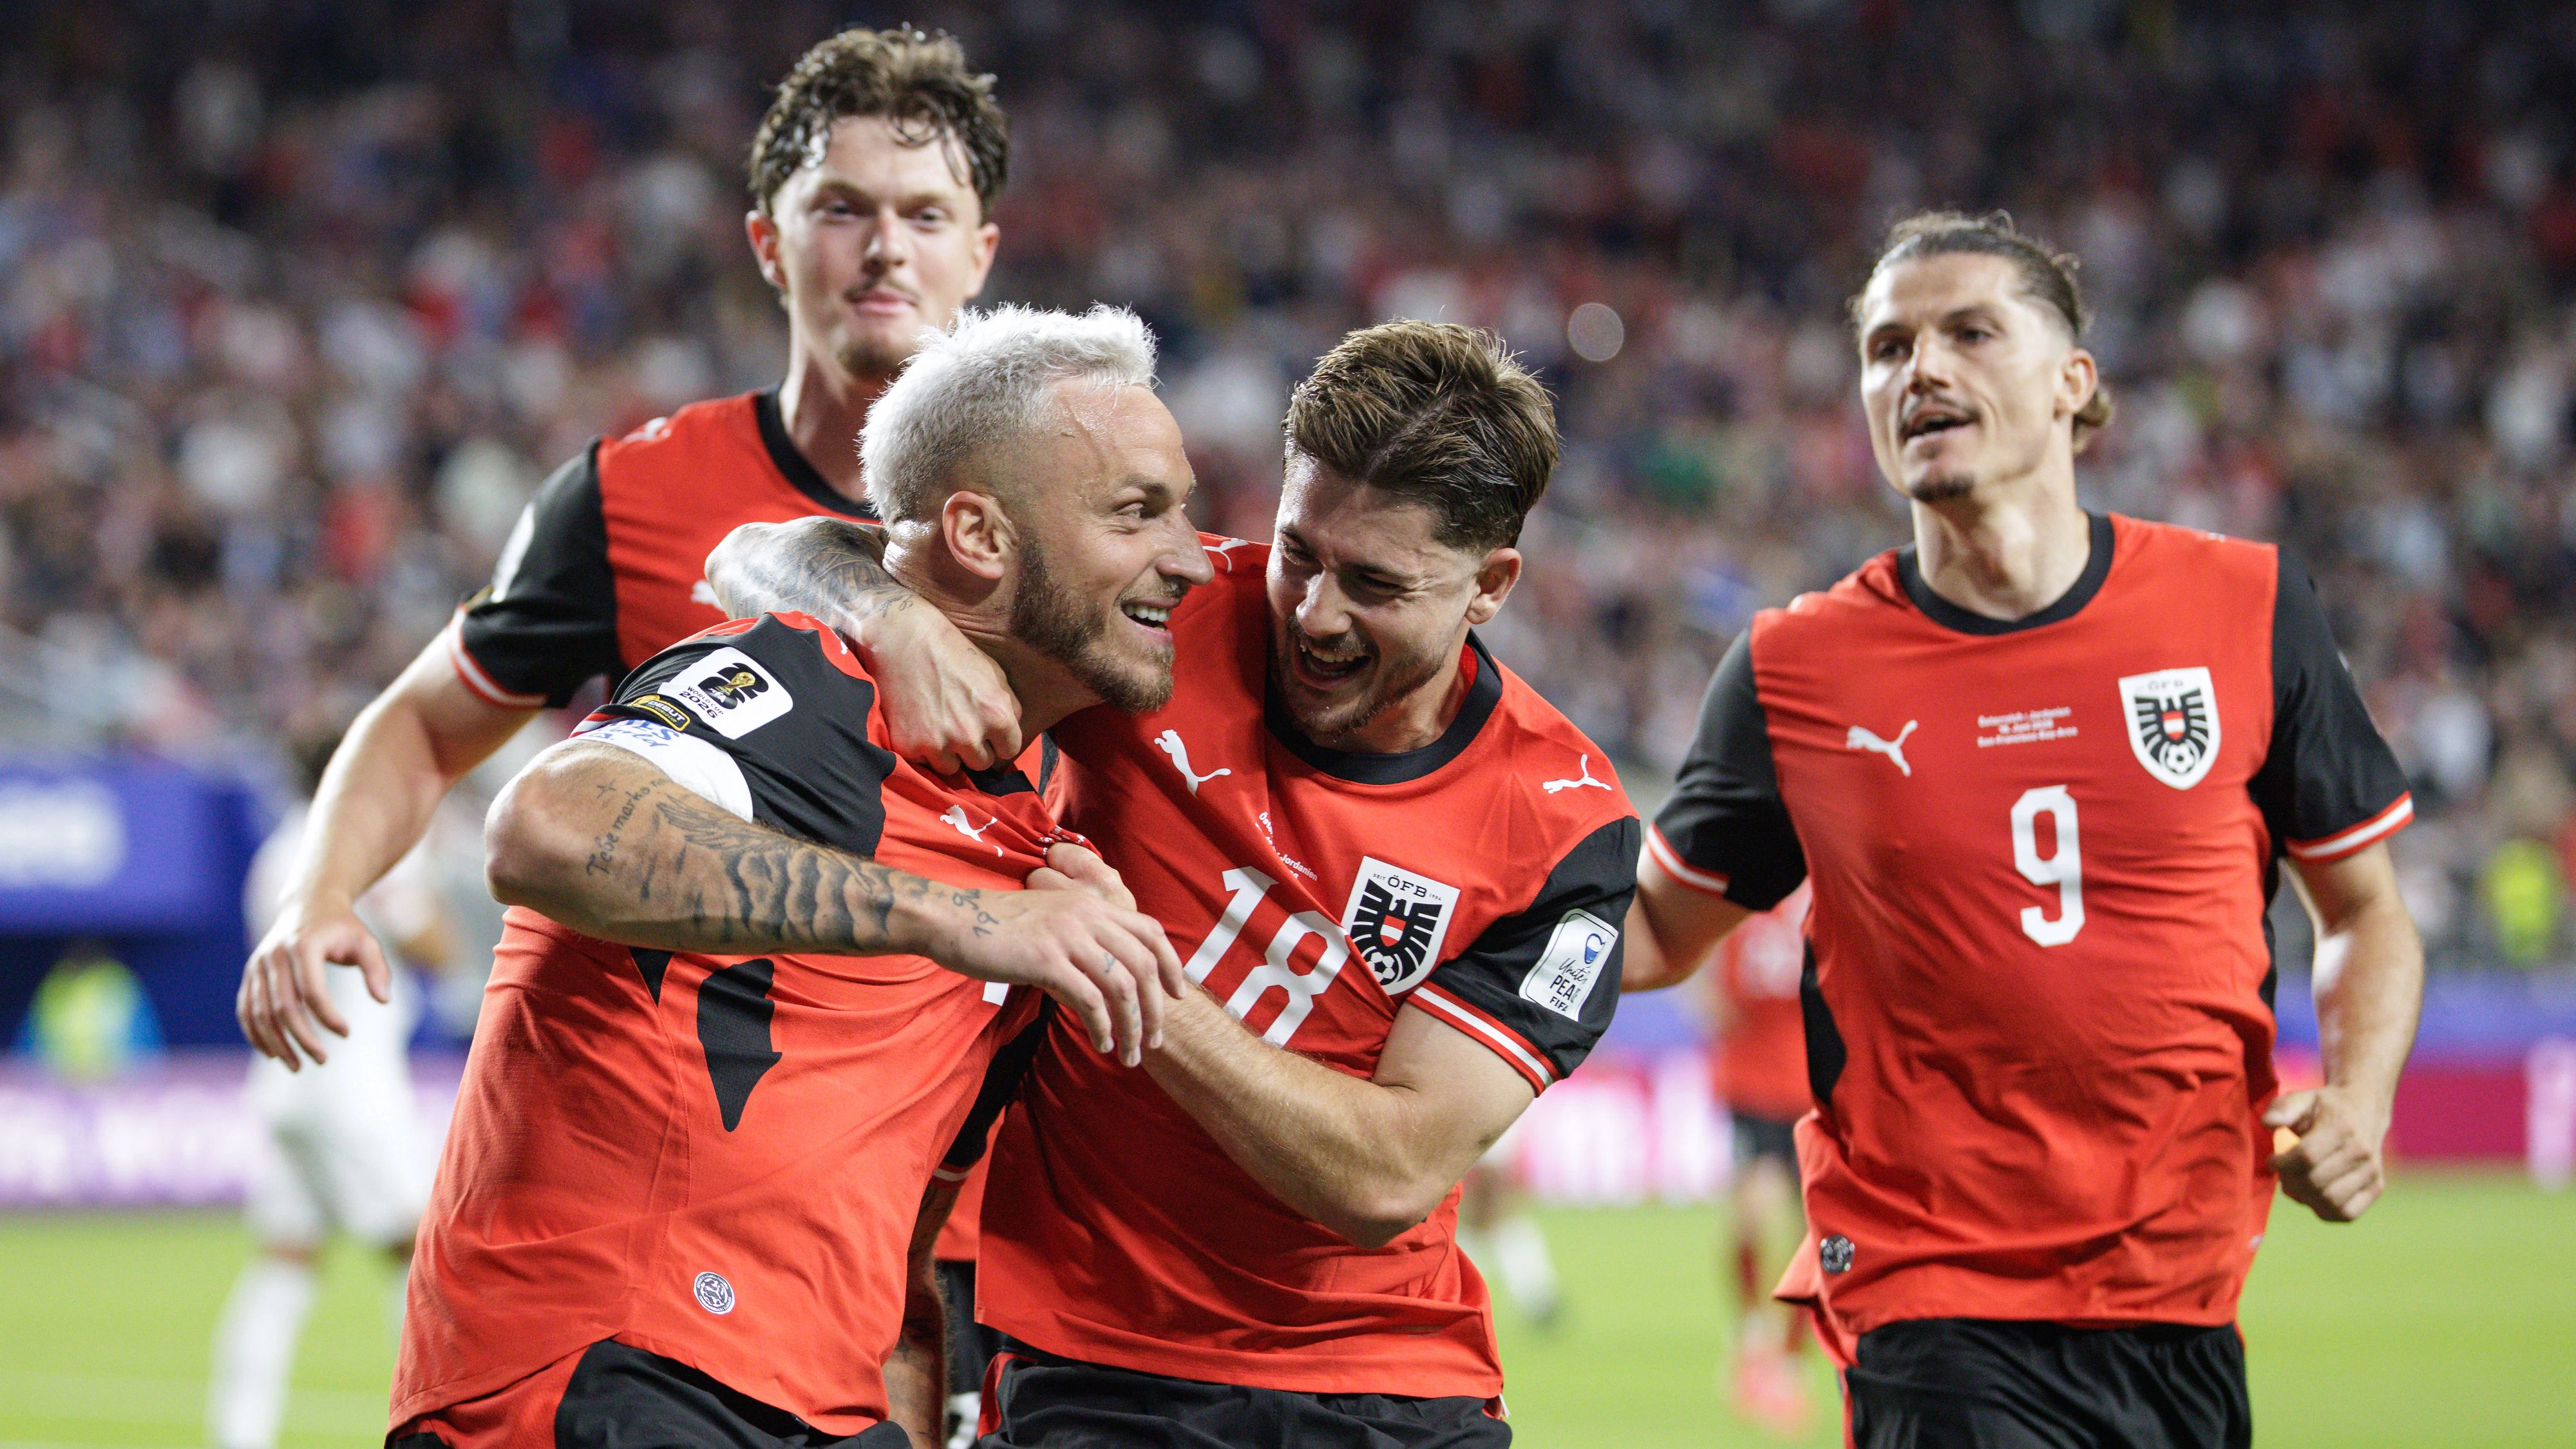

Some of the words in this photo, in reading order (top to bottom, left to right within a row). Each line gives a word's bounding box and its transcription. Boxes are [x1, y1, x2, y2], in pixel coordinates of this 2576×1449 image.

[648, 700, 687, 721] DEBUT
[679, 691, 718, 718] 2026
[687, 686, 711, 703] WORLD
[710, 703, 724, 715] CUP
[1280, 854, 1318, 881] Jordanien
[2011, 784, 2085, 947] 9
[1388, 875, 1427, 898] ÖFB
[1183, 866, 1351, 1049] 18
